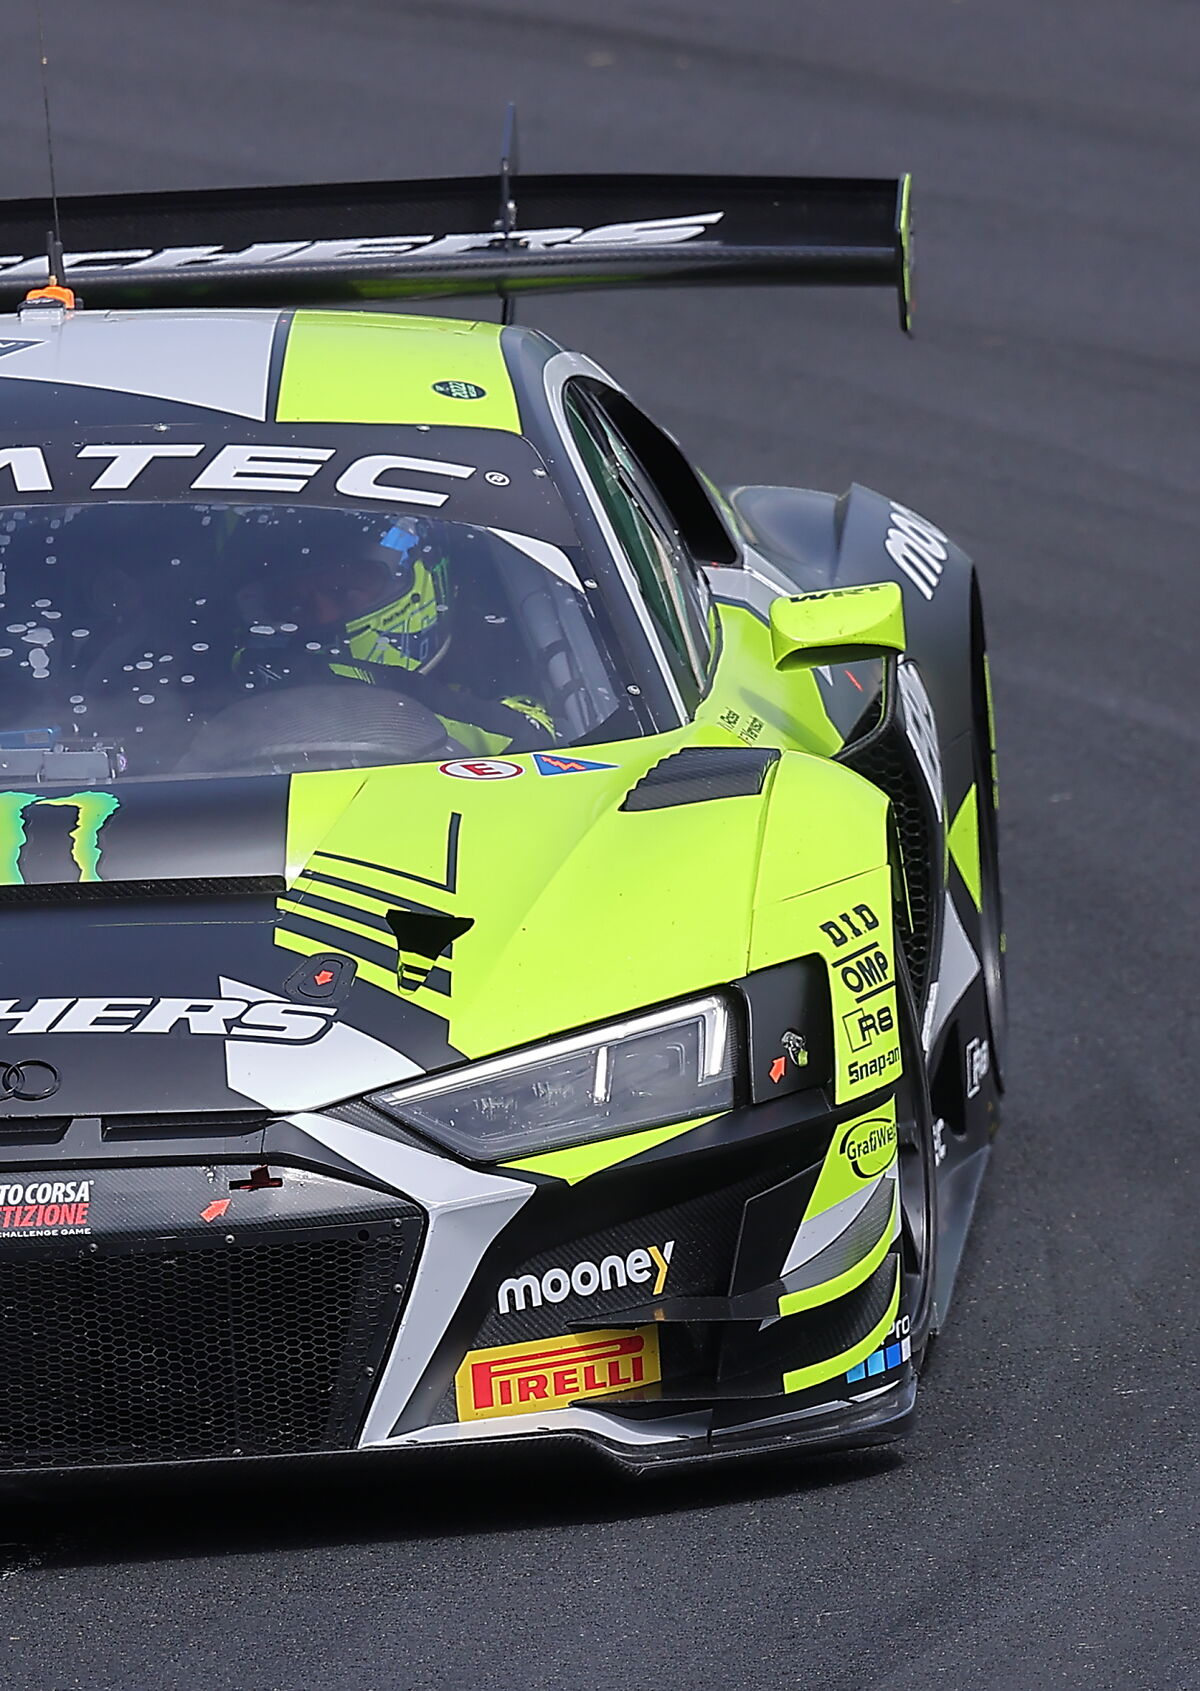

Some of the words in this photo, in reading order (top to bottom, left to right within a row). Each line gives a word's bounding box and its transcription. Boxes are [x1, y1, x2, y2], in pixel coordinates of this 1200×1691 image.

[459, 763, 503, 776] E
[841, 950, 889, 993] OMP
[857, 1006, 894, 1041] R8
[849, 1046, 900, 1085] Snap-on
[24, 1181, 90, 1205] CORSA
[498, 1241, 675, 1314] mooney
[473, 1335, 645, 1409] PIRELLI
